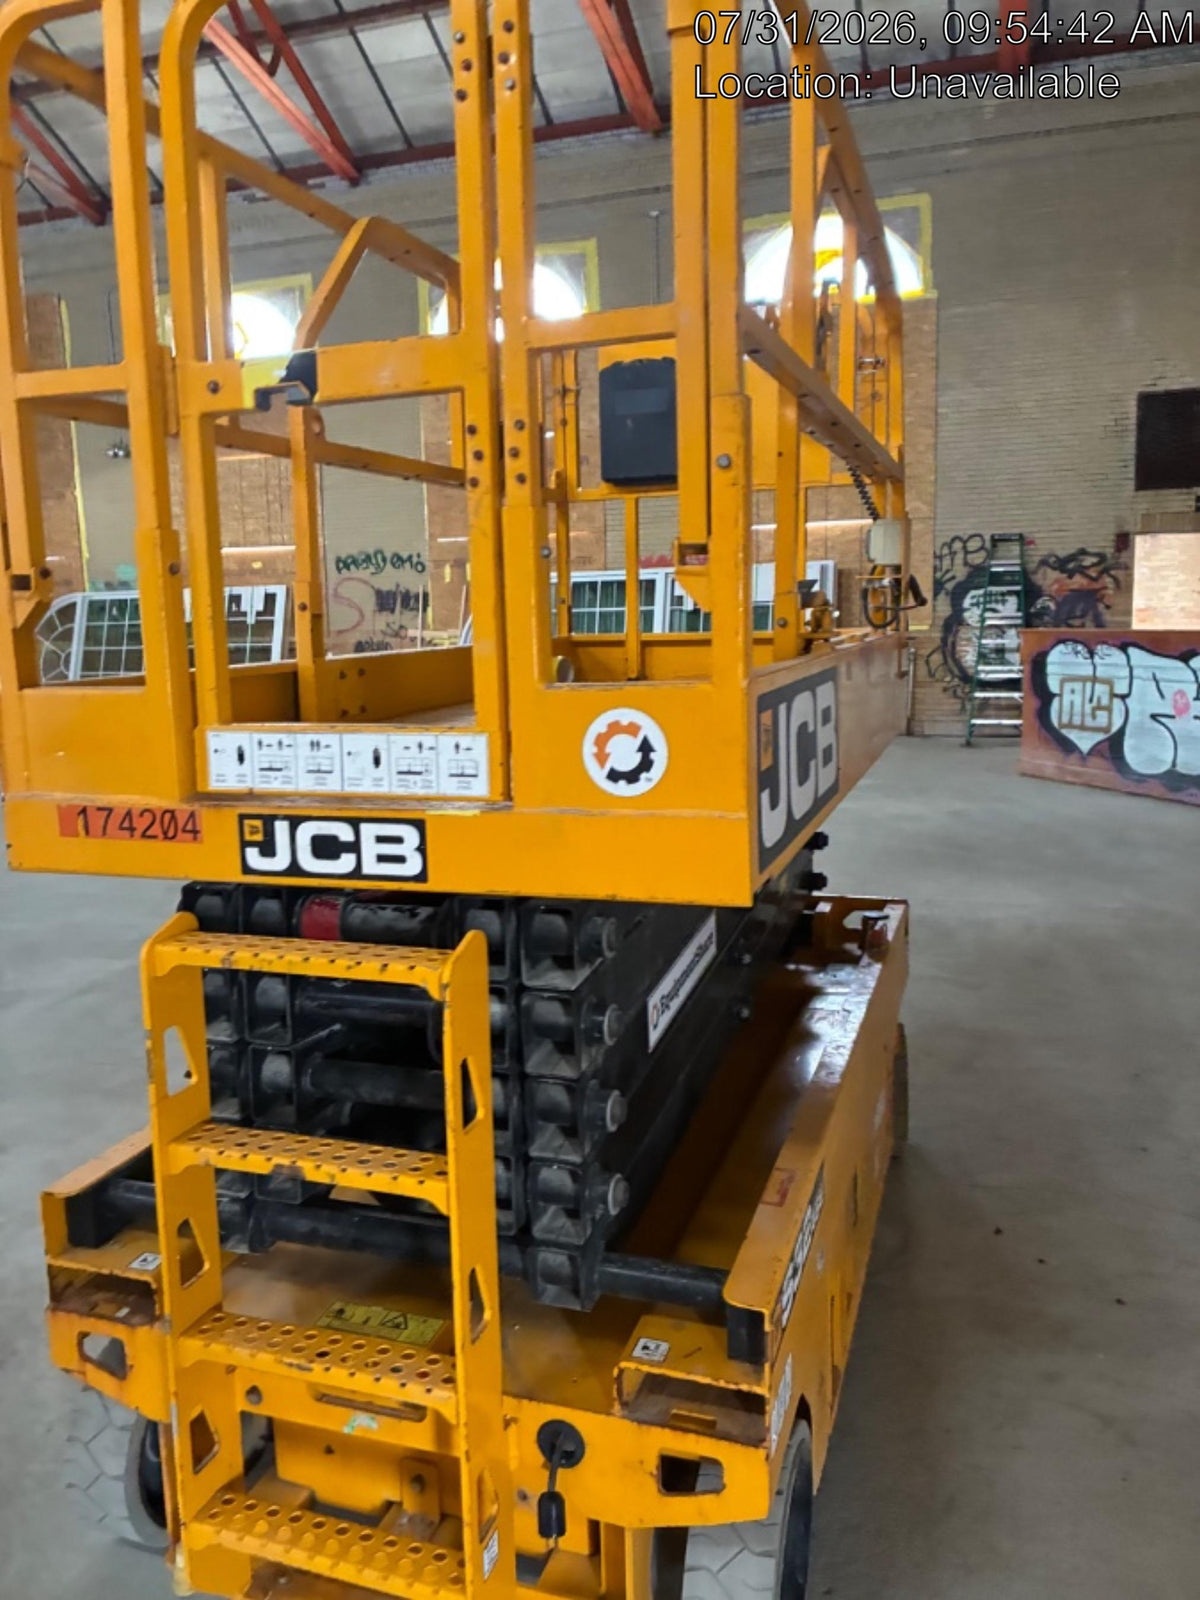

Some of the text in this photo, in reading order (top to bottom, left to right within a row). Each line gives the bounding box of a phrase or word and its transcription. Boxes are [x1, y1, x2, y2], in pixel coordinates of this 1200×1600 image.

[760, 680, 838, 849] JCB
[77, 805, 201, 841] 174204
[244, 819, 423, 877] JCB
